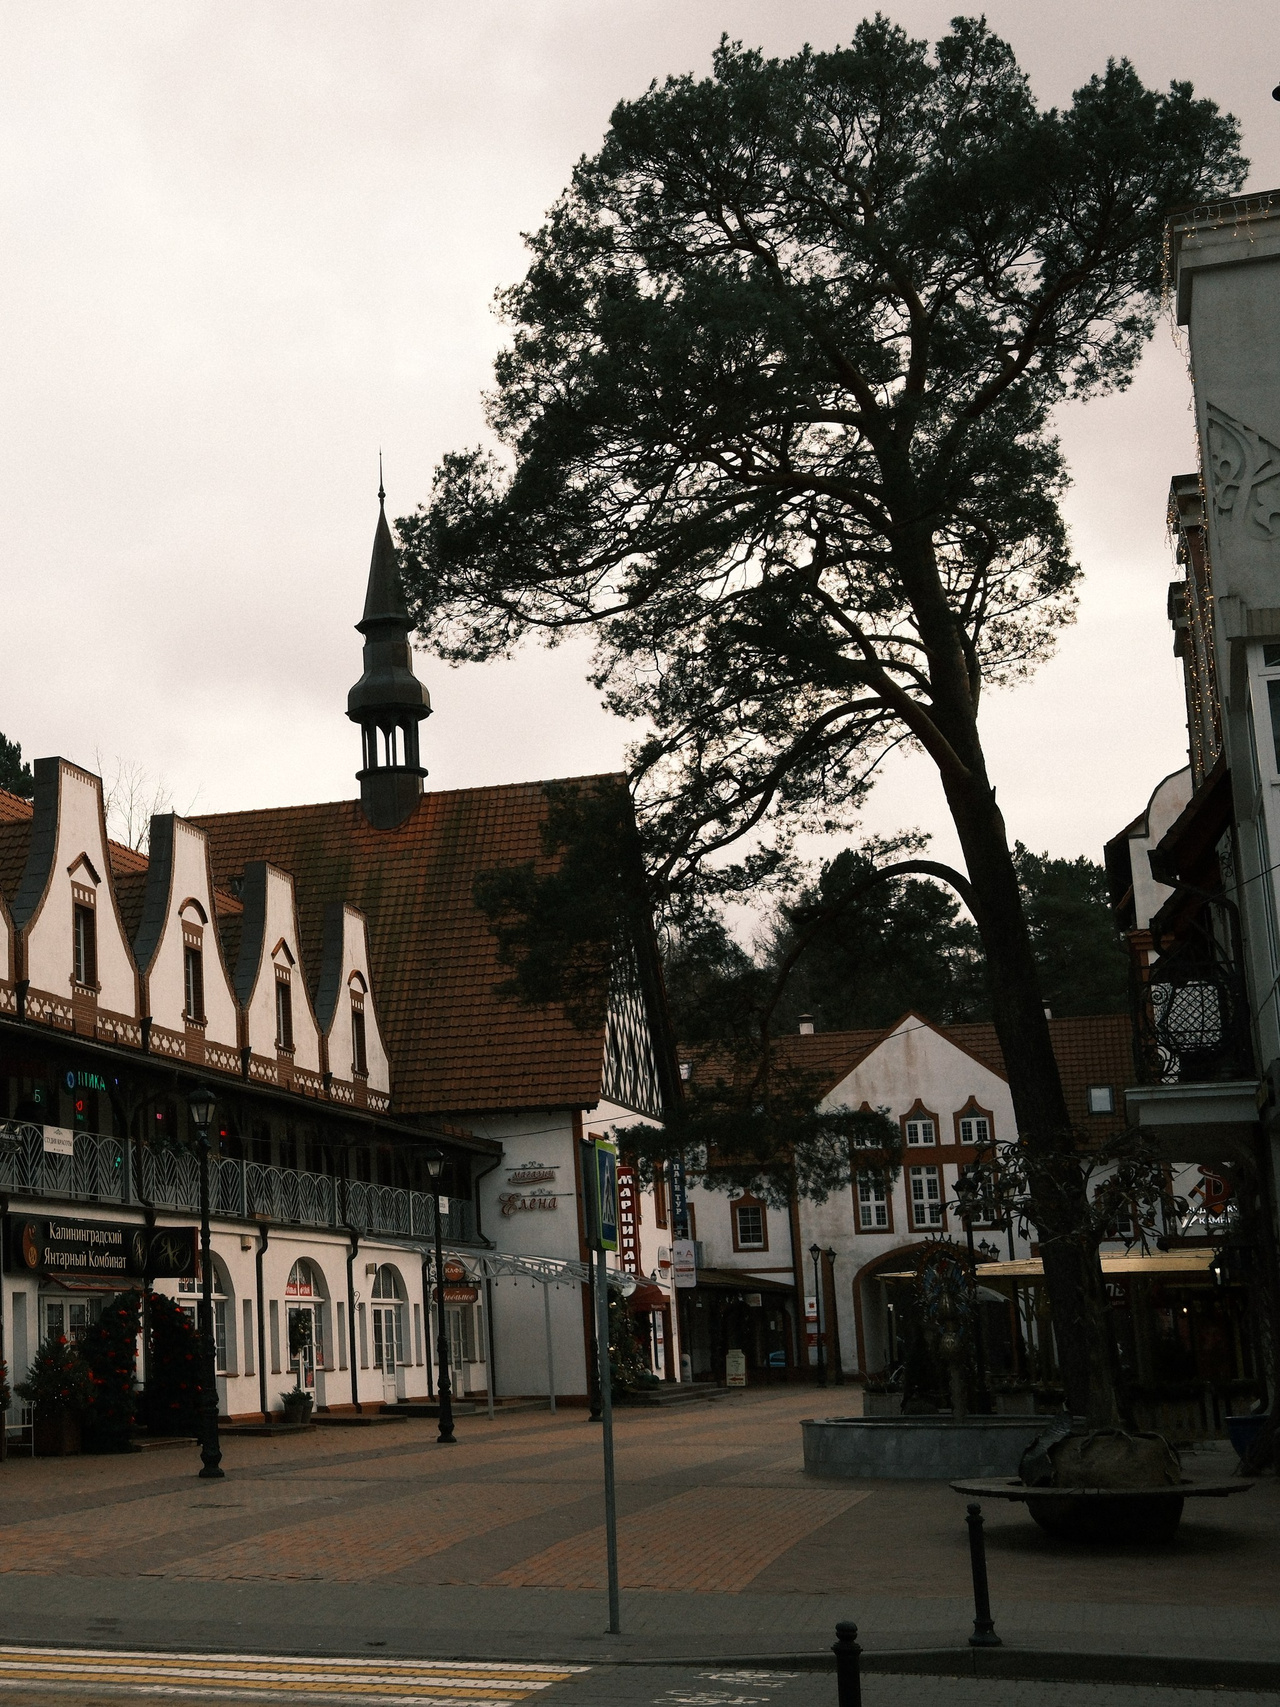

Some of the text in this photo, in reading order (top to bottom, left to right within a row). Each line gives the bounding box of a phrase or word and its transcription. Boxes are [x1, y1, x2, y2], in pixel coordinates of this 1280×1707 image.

[499, 1193, 557, 1216] Елена
[49, 1221, 123, 1247] Калининградский
[618, 1175, 636, 1272] МАРЦИПАН
[44, 1247, 127, 1270] Янтарный Комбинат
